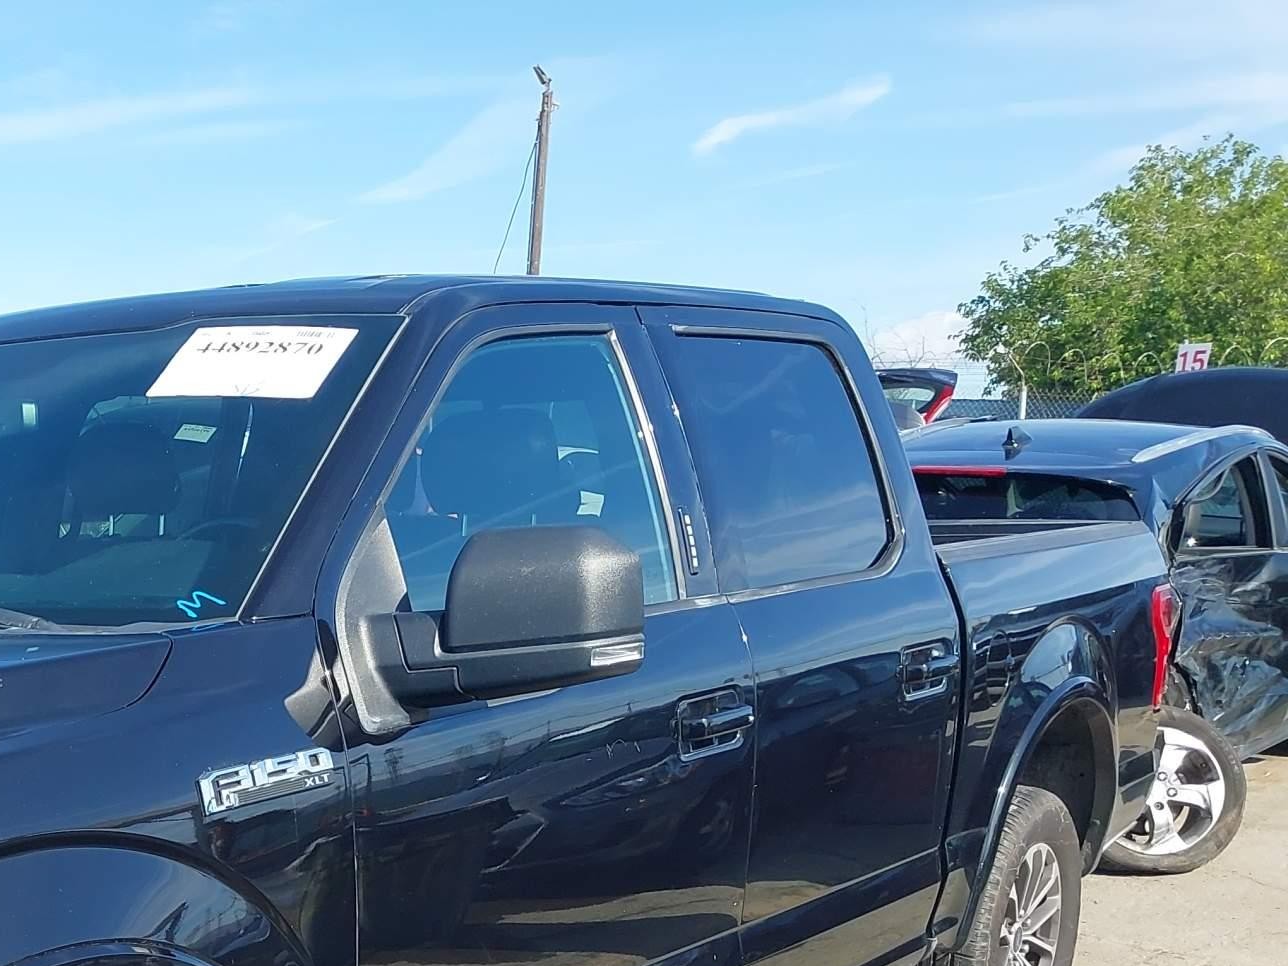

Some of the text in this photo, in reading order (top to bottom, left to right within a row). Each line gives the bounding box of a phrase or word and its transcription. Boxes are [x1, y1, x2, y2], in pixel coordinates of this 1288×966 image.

[196, 341, 324, 355] 44892870
[1177, 350, 1208, 373] 15
[304, 773, 331, 788] XLT
